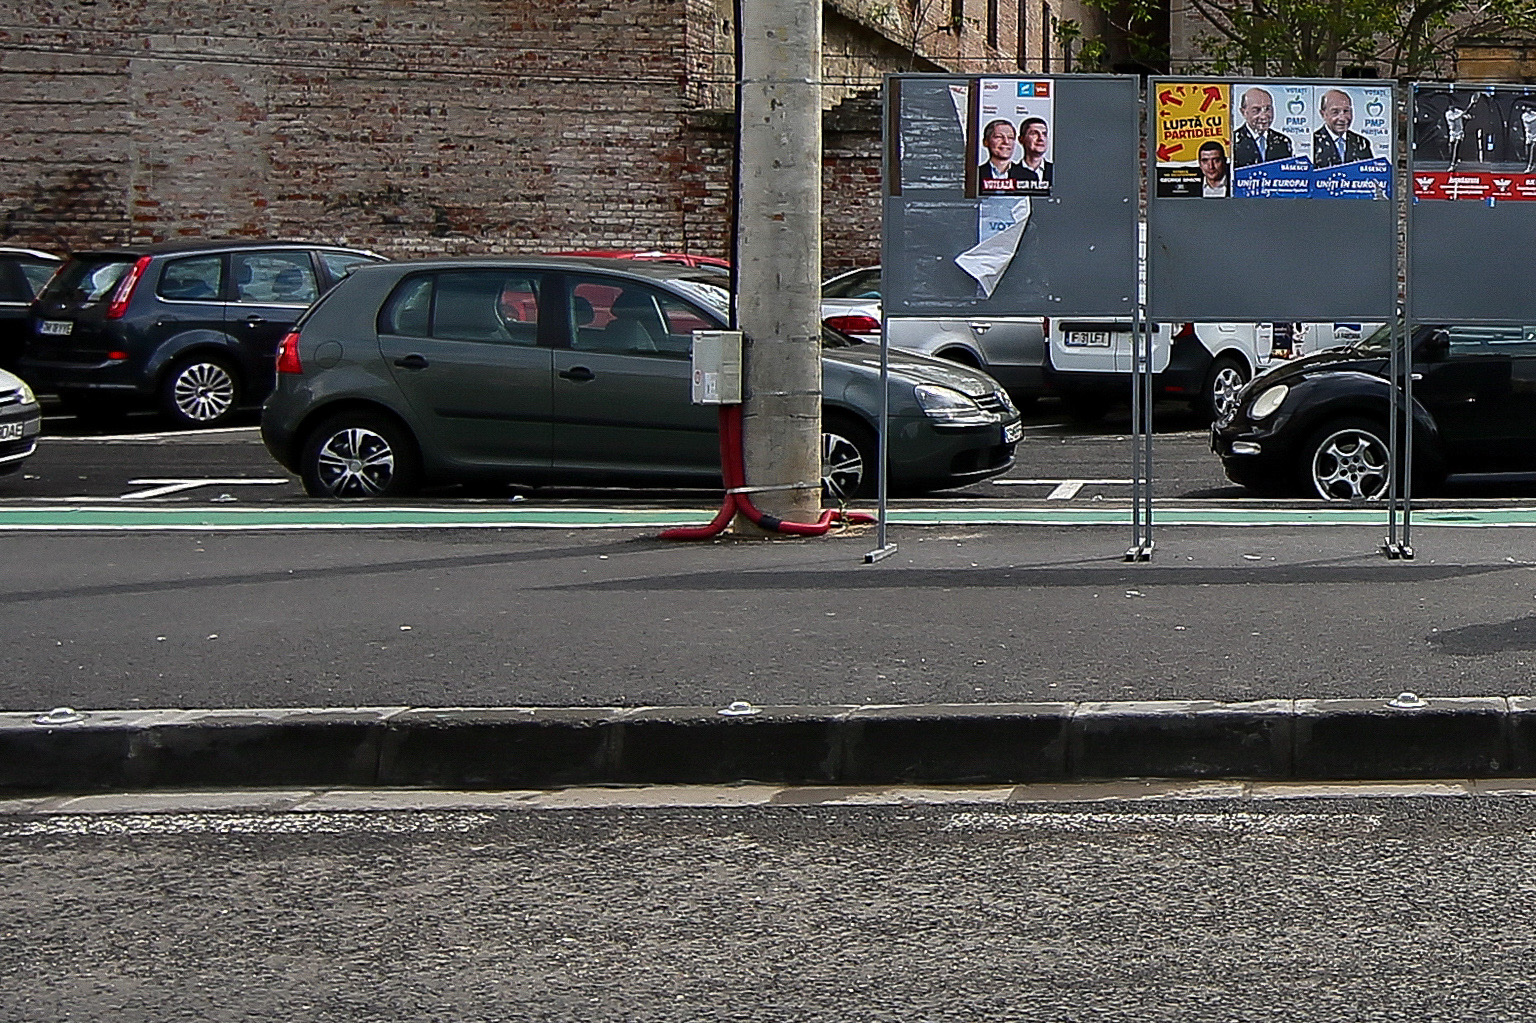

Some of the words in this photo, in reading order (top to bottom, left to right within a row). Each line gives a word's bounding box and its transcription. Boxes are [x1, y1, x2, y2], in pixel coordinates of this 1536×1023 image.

[1163, 115, 1203, 130] LUPTĂ
[1206, 117, 1222, 127] CU
[1365, 119, 1385, 127] PMP
[1164, 128, 1223, 140] PARTIDELE
